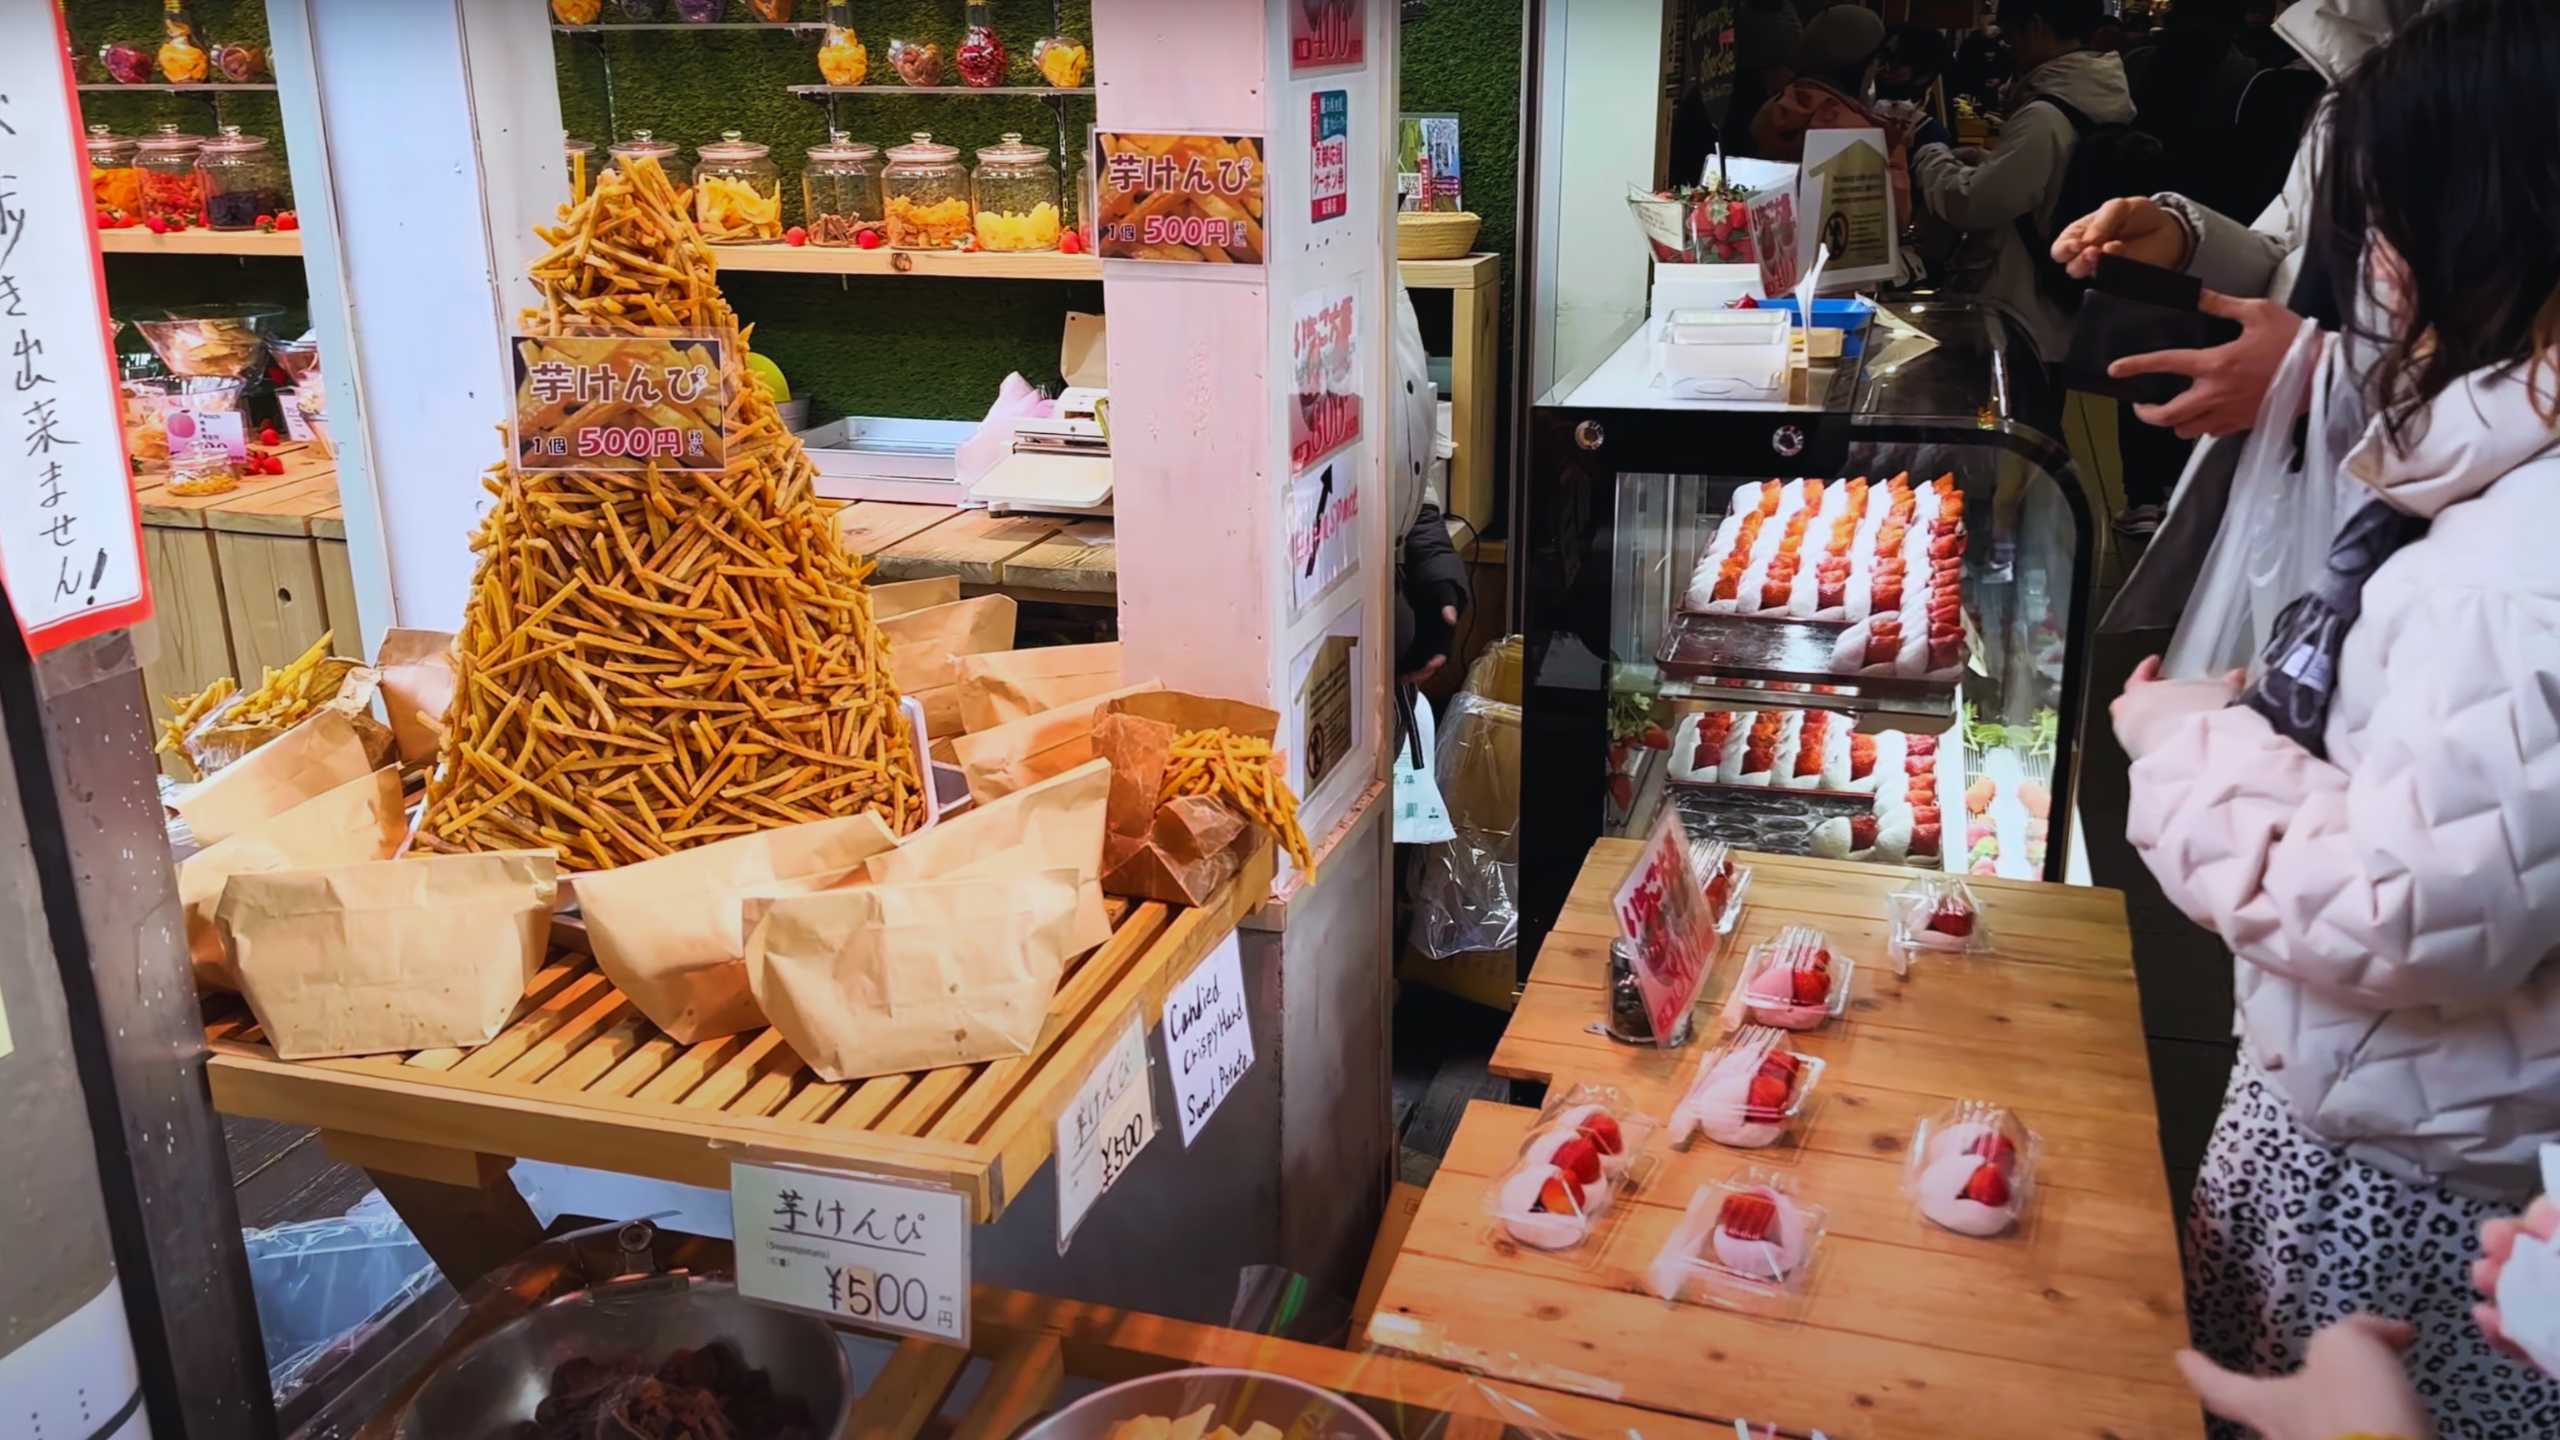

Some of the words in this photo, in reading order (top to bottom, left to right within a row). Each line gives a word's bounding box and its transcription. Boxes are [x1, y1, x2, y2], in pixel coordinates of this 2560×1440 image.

[1109, 153, 1253, 195] 芋けんぴ
[1144, 215, 1231, 247] 500円
[0, 94, 108, 606] き出来ません!
[530, 361, 707, 404] 芋けんぴ
[532, 436, 567, 456] 1個
[577, 427, 684, 458] 500円
[1169, 973, 1221, 1042] Candied
[1101, 1113, 1144, 1188] ¥500
[773, 1189, 926, 1245] 芋けんぴ
[824, 1265, 928, 1322] ¥500
